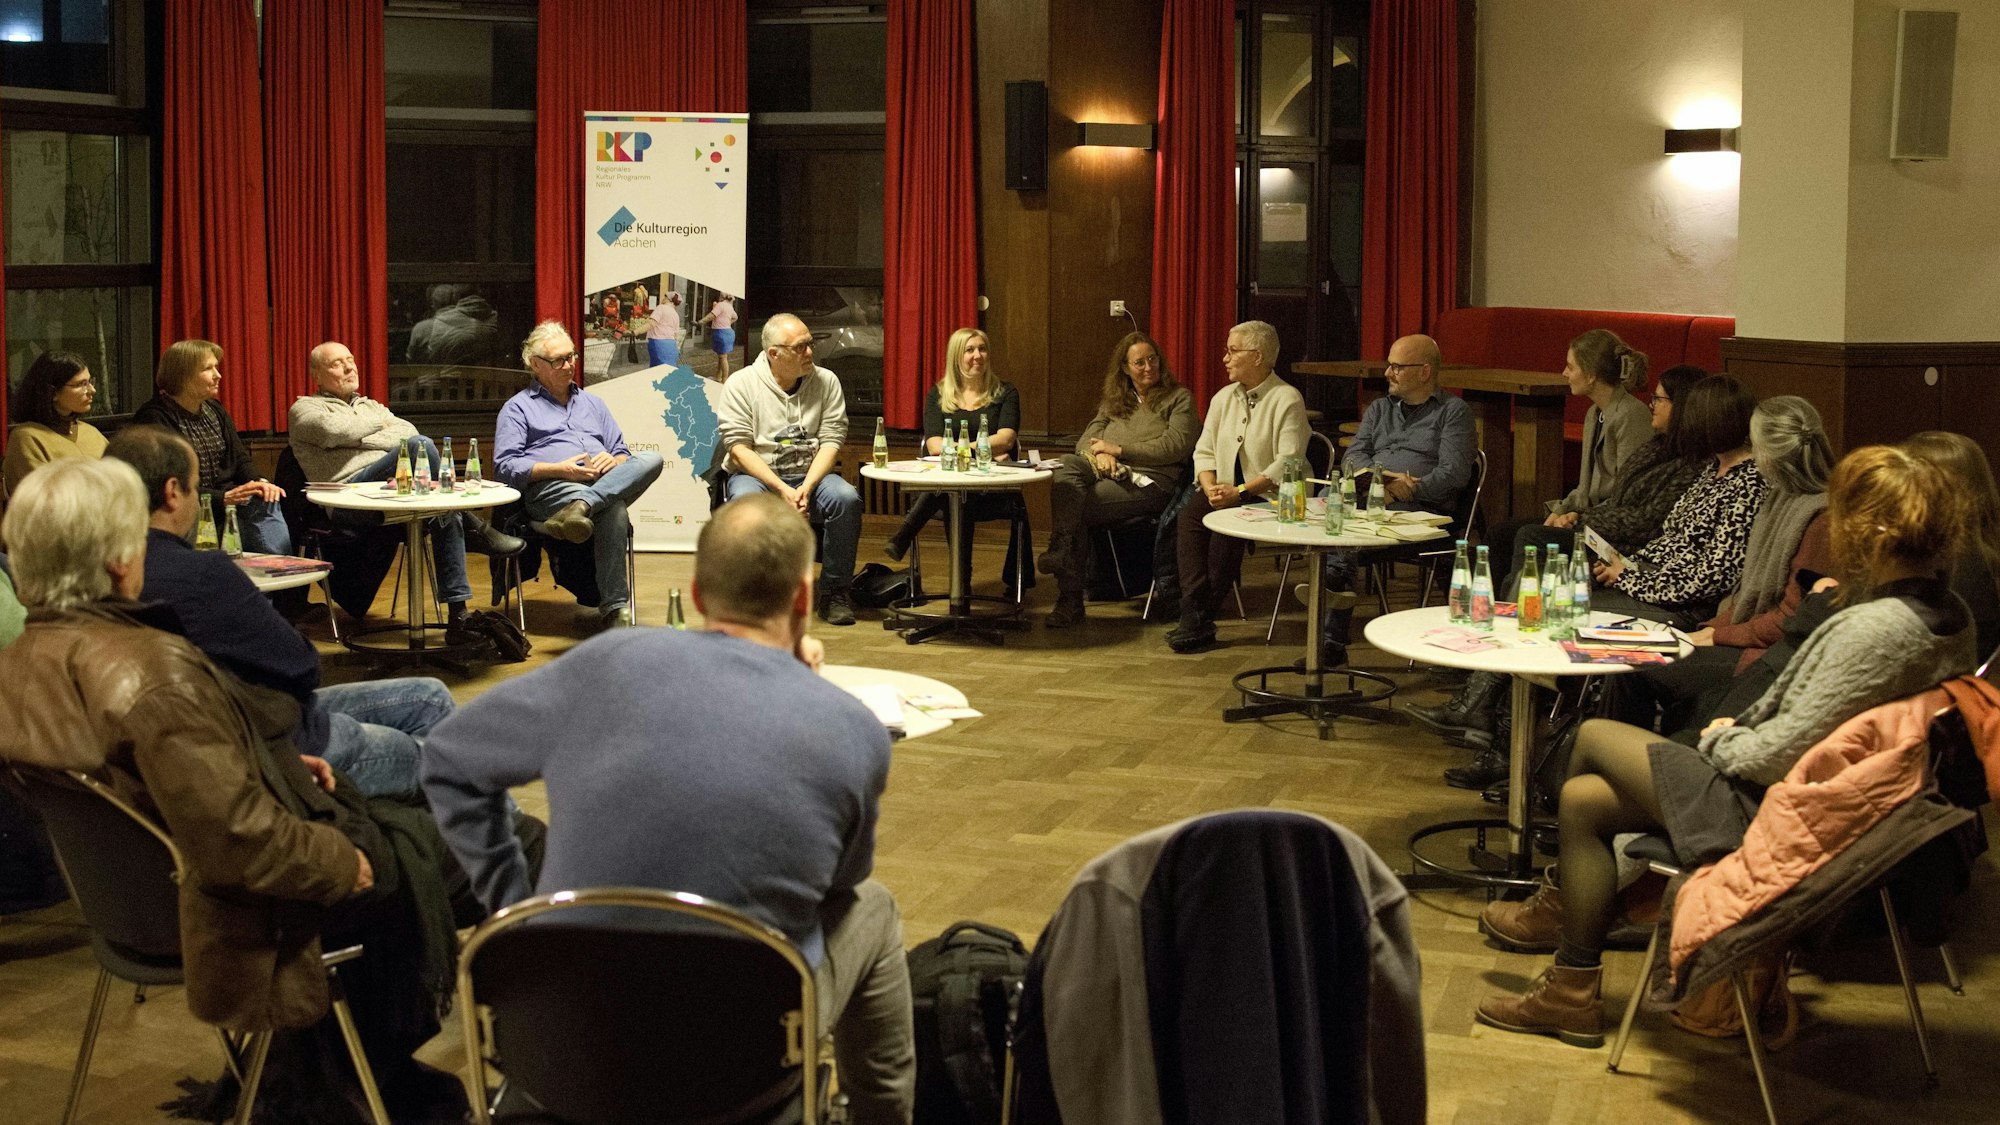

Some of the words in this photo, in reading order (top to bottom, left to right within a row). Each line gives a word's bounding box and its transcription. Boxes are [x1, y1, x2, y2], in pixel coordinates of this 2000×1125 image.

[597, 131, 652, 162] RKP
[596, 165, 631, 173] Regionales
[617, 174, 651, 182] Programm
[614, 221, 633, 233] Die
[637, 222, 708, 237] Kulturregion
[613, 238, 657, 248] Aachen
